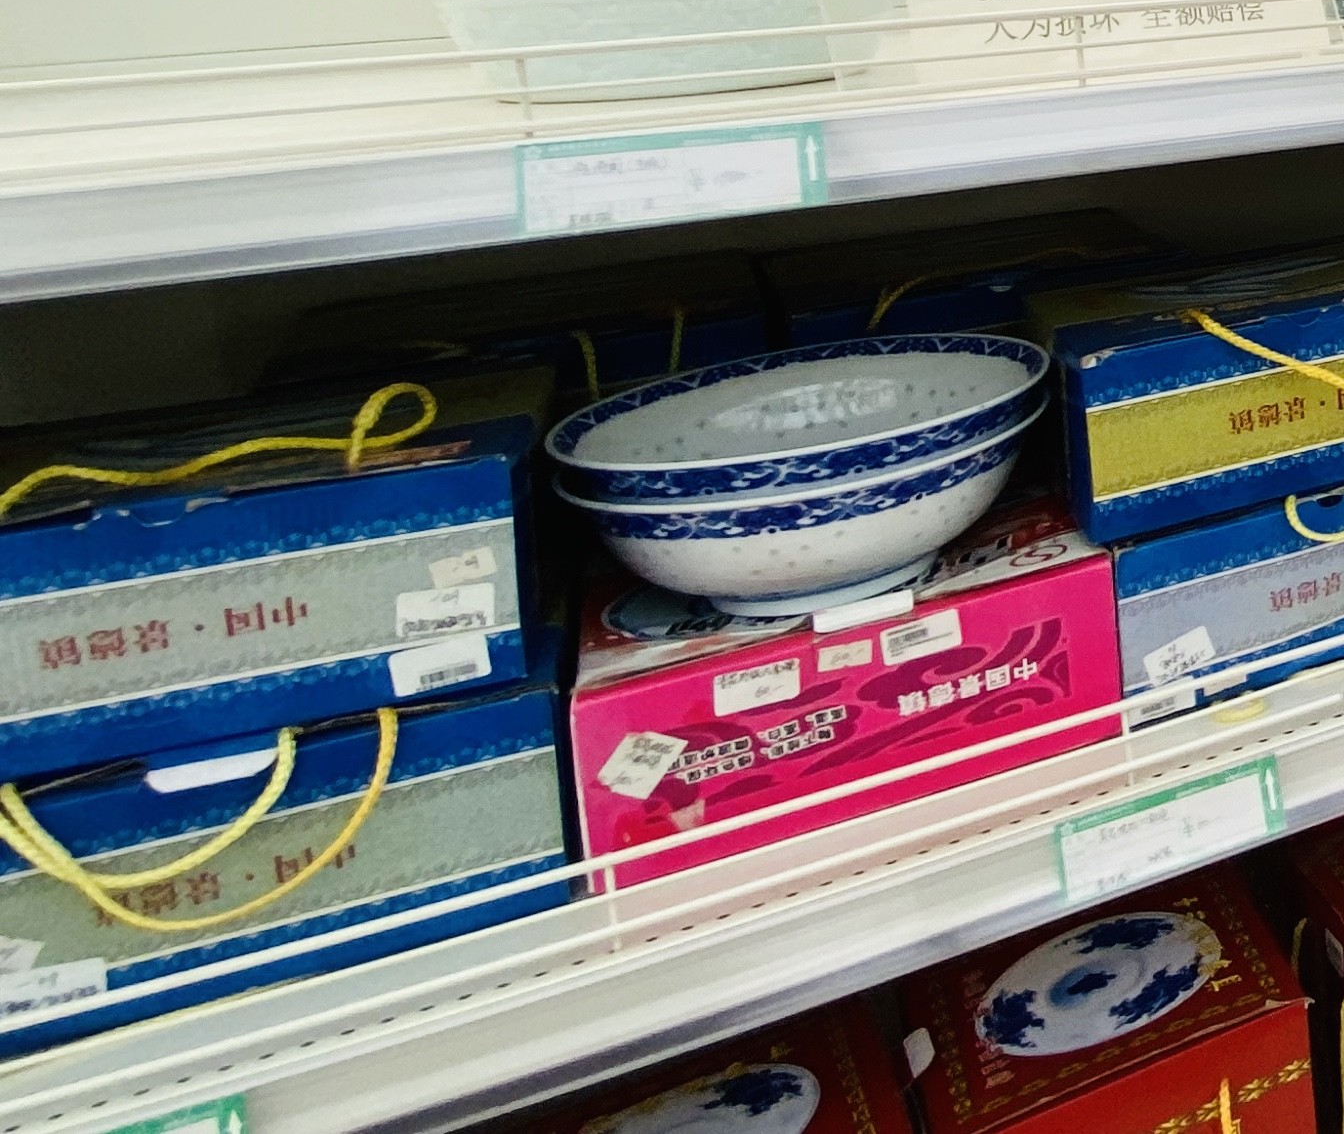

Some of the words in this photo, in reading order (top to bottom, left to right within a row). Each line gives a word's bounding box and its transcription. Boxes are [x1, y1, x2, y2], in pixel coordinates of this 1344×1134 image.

[37, 595, 311, 671] 中国·景德镇
[897, 657, 1039, 717] 中国景德镇
